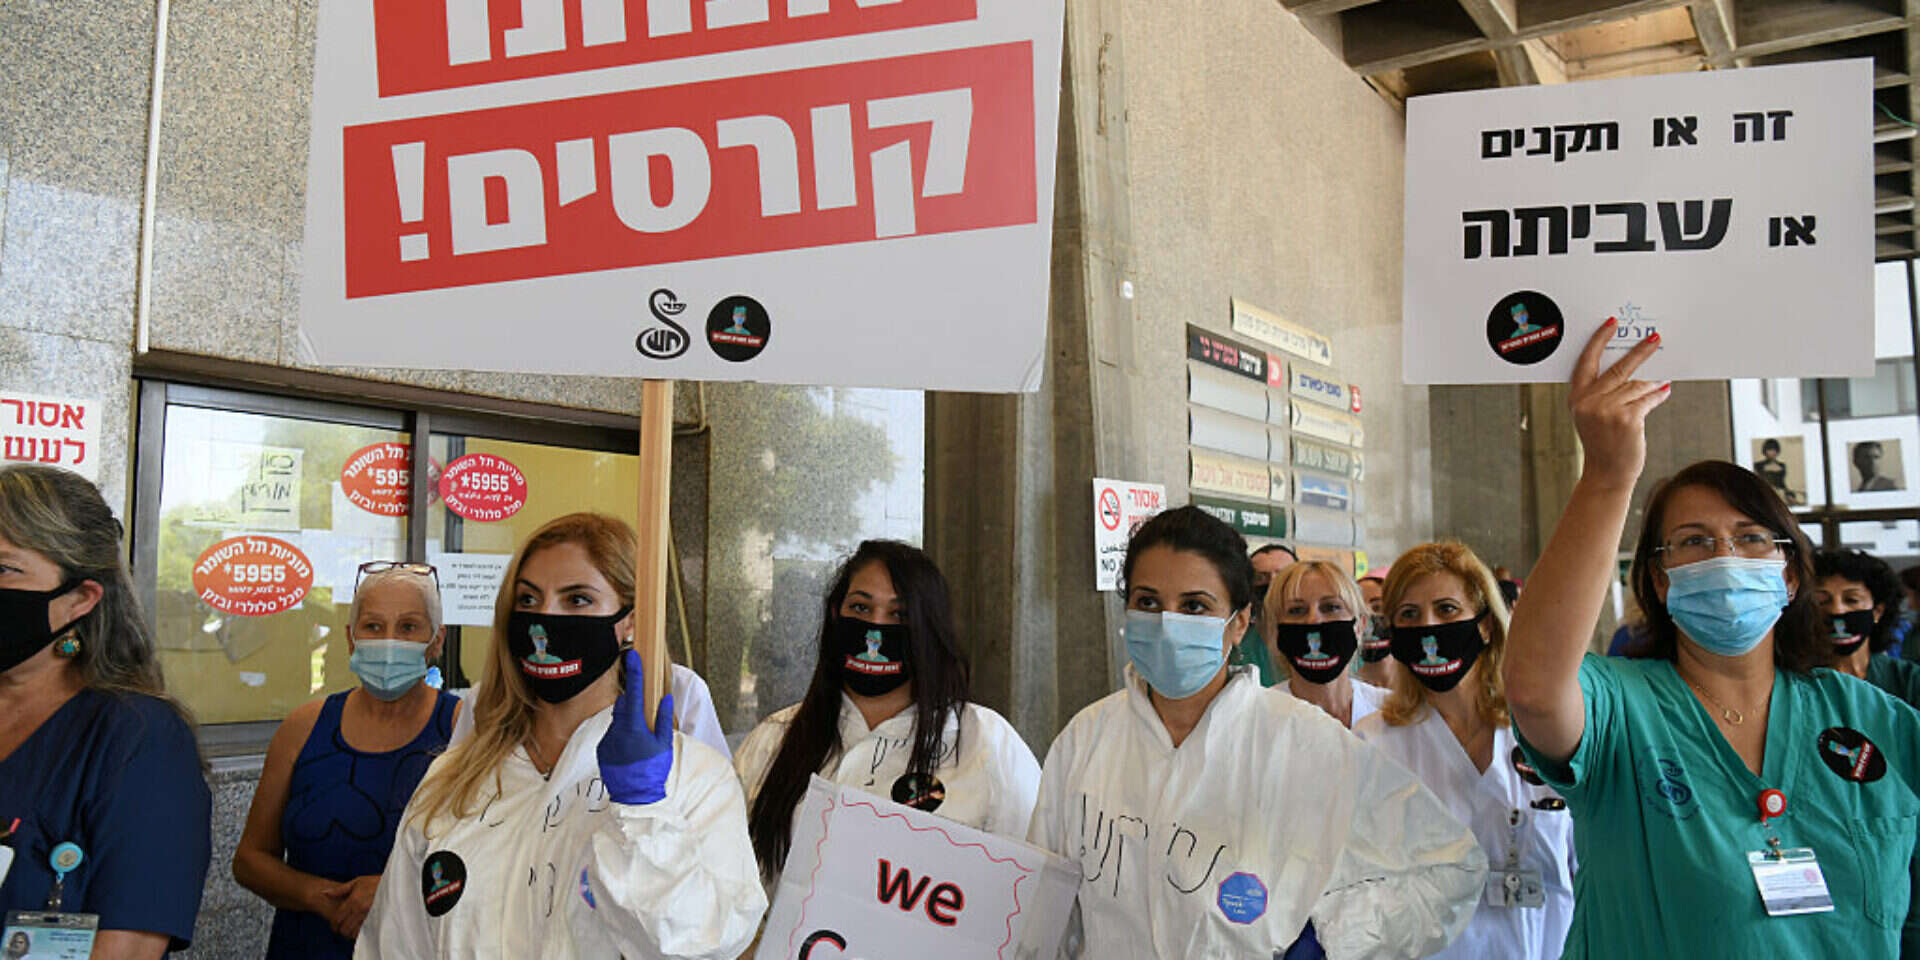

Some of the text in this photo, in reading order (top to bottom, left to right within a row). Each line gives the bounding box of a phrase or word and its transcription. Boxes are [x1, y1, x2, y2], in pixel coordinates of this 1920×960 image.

[1481, 110, 1793, 163] זה או תקנים
[391, 87, 973, 262] קורסים!
[1462, 198, 1816, 259] או שביתה
[0, 399, 85, 430] אסור
[344, 444, 403, 479] תל השומר
[479, 455, 495, 468] תל
[498, 461, 525, 486] מוניות
[350, 490, 376, 509] ובזק
[1128, 488, 1160, 508] אסור
[195, 537, 310, 578] מוניות תל השומר
[1101, 558, 1117, 573] NO
[201, 587, 232, 610] ובזק
[235, 600, 277, 614] סלולרי
[278, 587, 304, 607] מכל
[877, 858, 965, 927] we
